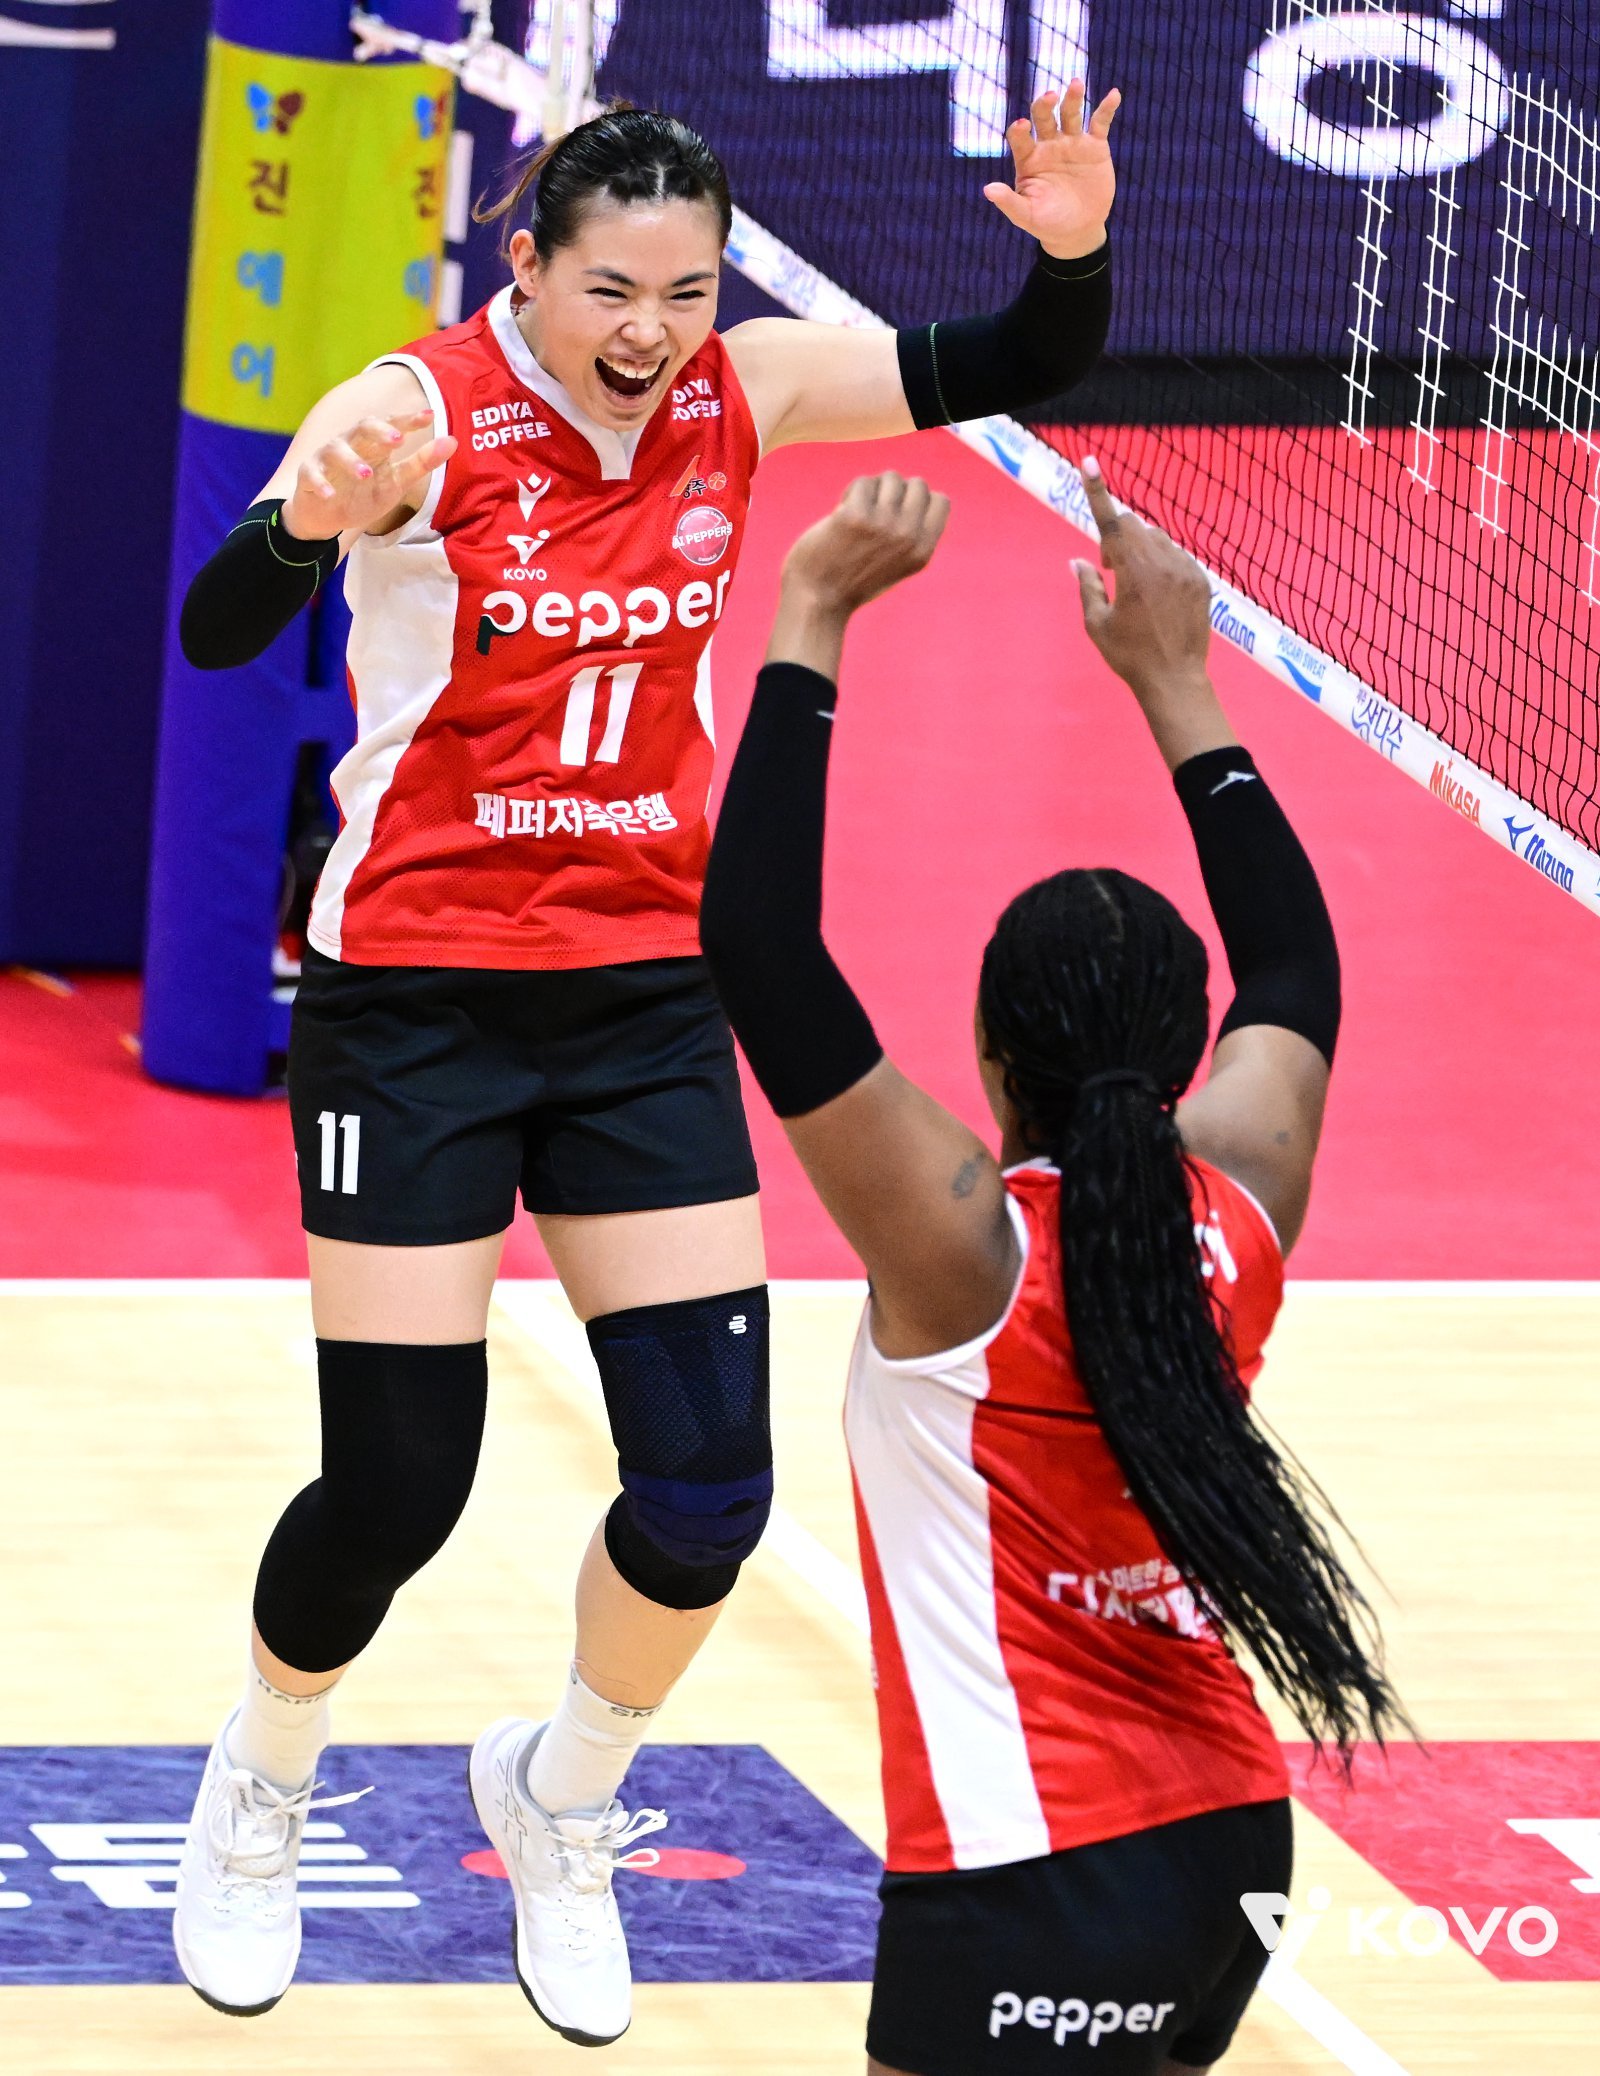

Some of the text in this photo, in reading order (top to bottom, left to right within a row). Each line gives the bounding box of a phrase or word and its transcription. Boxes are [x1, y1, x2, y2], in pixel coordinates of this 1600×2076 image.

[673, 378, 713, 404] DIYA
[471, 402, 534, 429] EDIYA
[471, 421, 552, 451] COFFEE
[685, 521, 733, 545] PEPPERS
[503, 568, 548, 582] KOVO
[476, 569, 731, 656] pepper
[1302, 651, 1327, 681] SWEAT
[560, 662, 645, 767] 11
[1351, 697, 1404, 761] 삼다수
[473, 791, 679, 839] 페퍼저축은행
[317, 1110, 361, 1195] 11
[989, 1990, 1176, 2048] pepper
